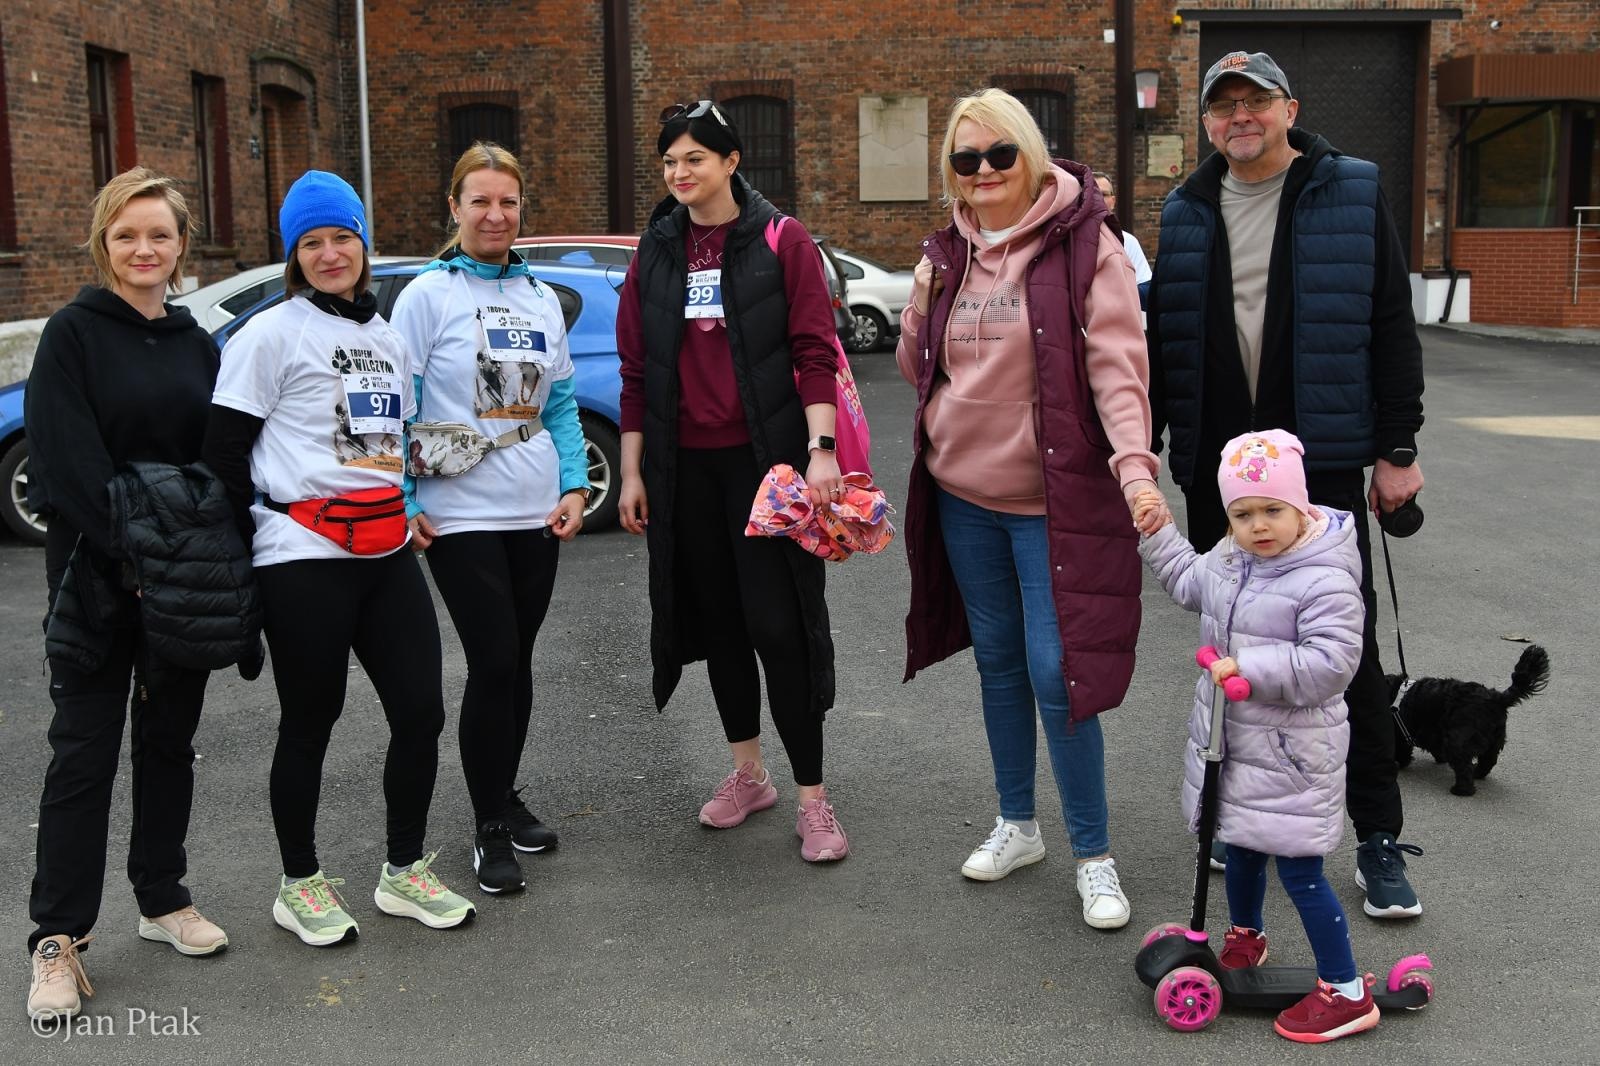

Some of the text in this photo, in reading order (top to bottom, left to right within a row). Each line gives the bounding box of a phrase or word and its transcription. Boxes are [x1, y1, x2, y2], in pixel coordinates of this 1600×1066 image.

[686, 248, 712, 271] and
[688, 286, 714, 305] 99
[486, 306, 511, 314] TROPEM
[507, 330, 533, 349] 95
[350, 349, 373, 359] TROPEM
[353, 358, 395, 375] WILCZYM
[369, 393, 391, 416] 97
